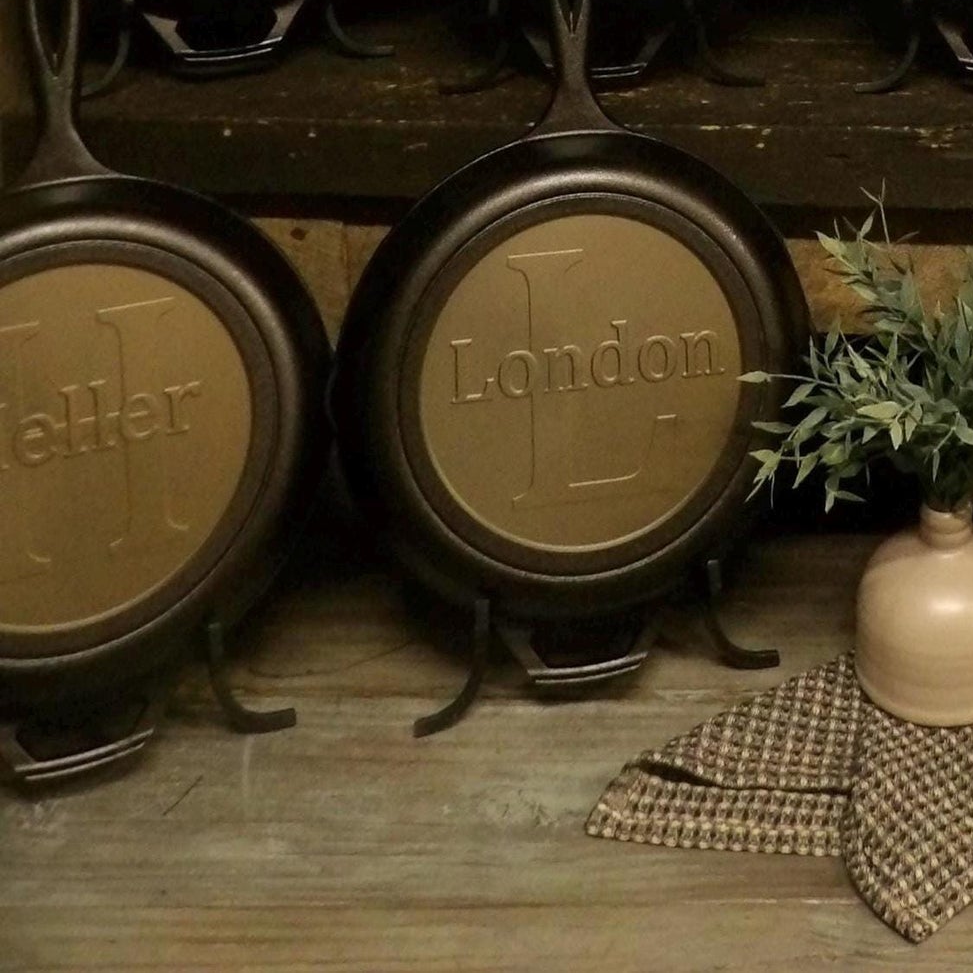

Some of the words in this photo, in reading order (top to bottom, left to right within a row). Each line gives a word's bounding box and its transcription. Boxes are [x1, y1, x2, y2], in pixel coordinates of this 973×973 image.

[450, 319, 726, 404] London
[506, 247, 678, 510] L
[0, 379, 201, 469] eller
